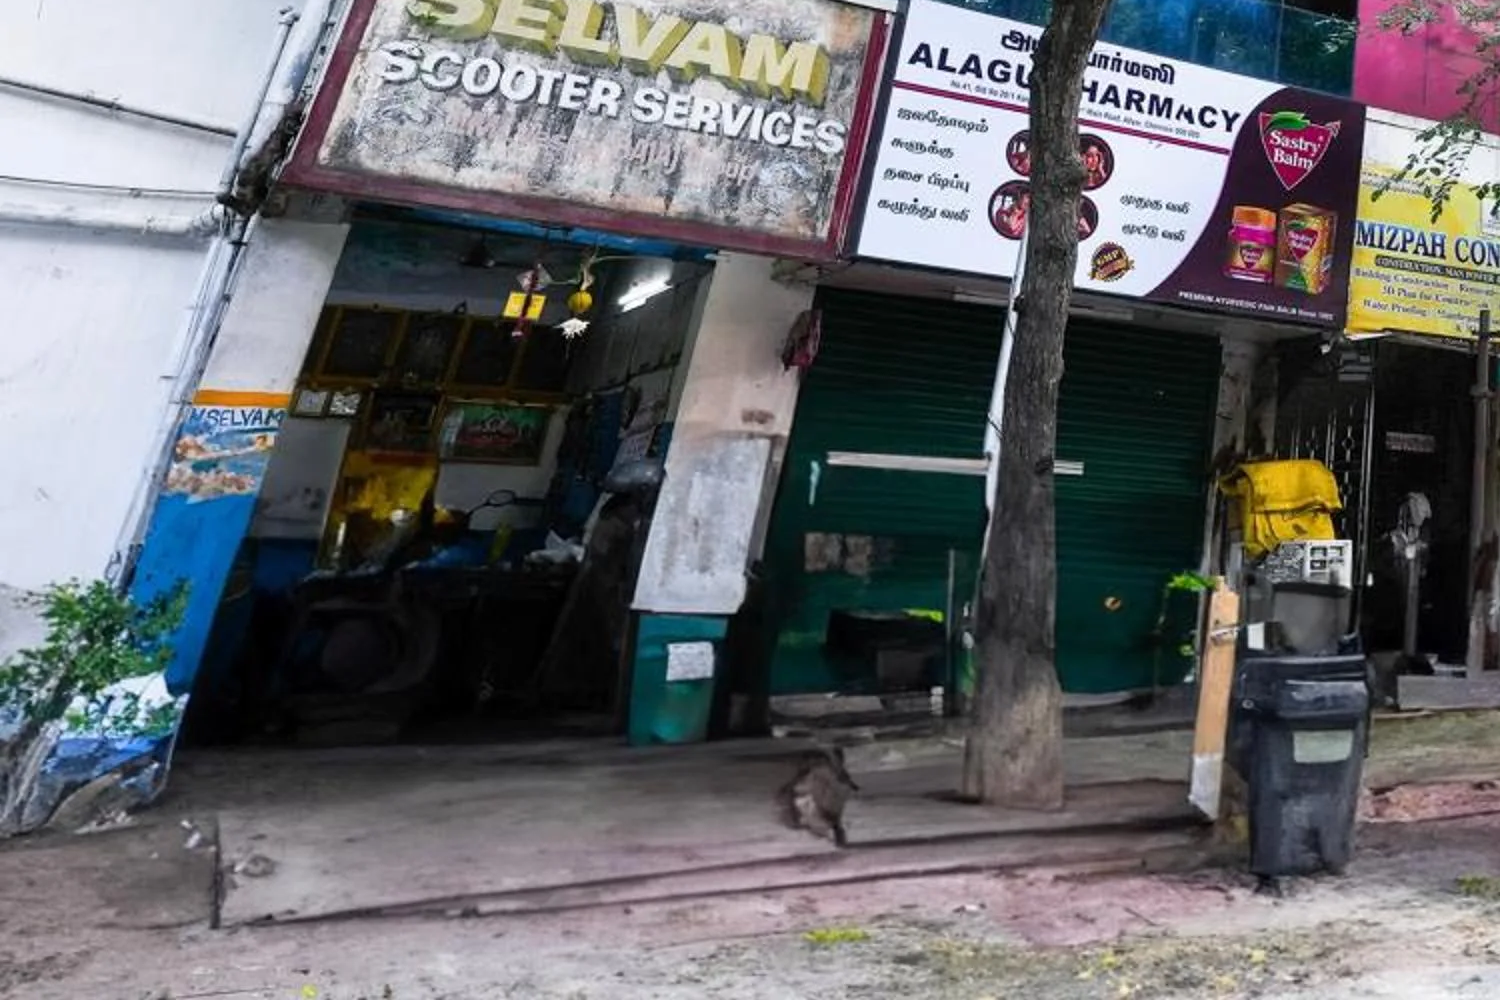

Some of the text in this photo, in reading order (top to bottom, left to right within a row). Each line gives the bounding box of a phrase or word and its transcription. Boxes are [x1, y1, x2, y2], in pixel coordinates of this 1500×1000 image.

[381, 40, 624, 119] SCOOTER
[631, 86, 847, 155] SERVICES
[908, 42, 1241, 133] ALAGU HARMACY
[1269, 128, 1321, 156] Sastry
[1274, 147, 1315, 170] Balm
[1355, 220, 1447, 260] MIZPAH
